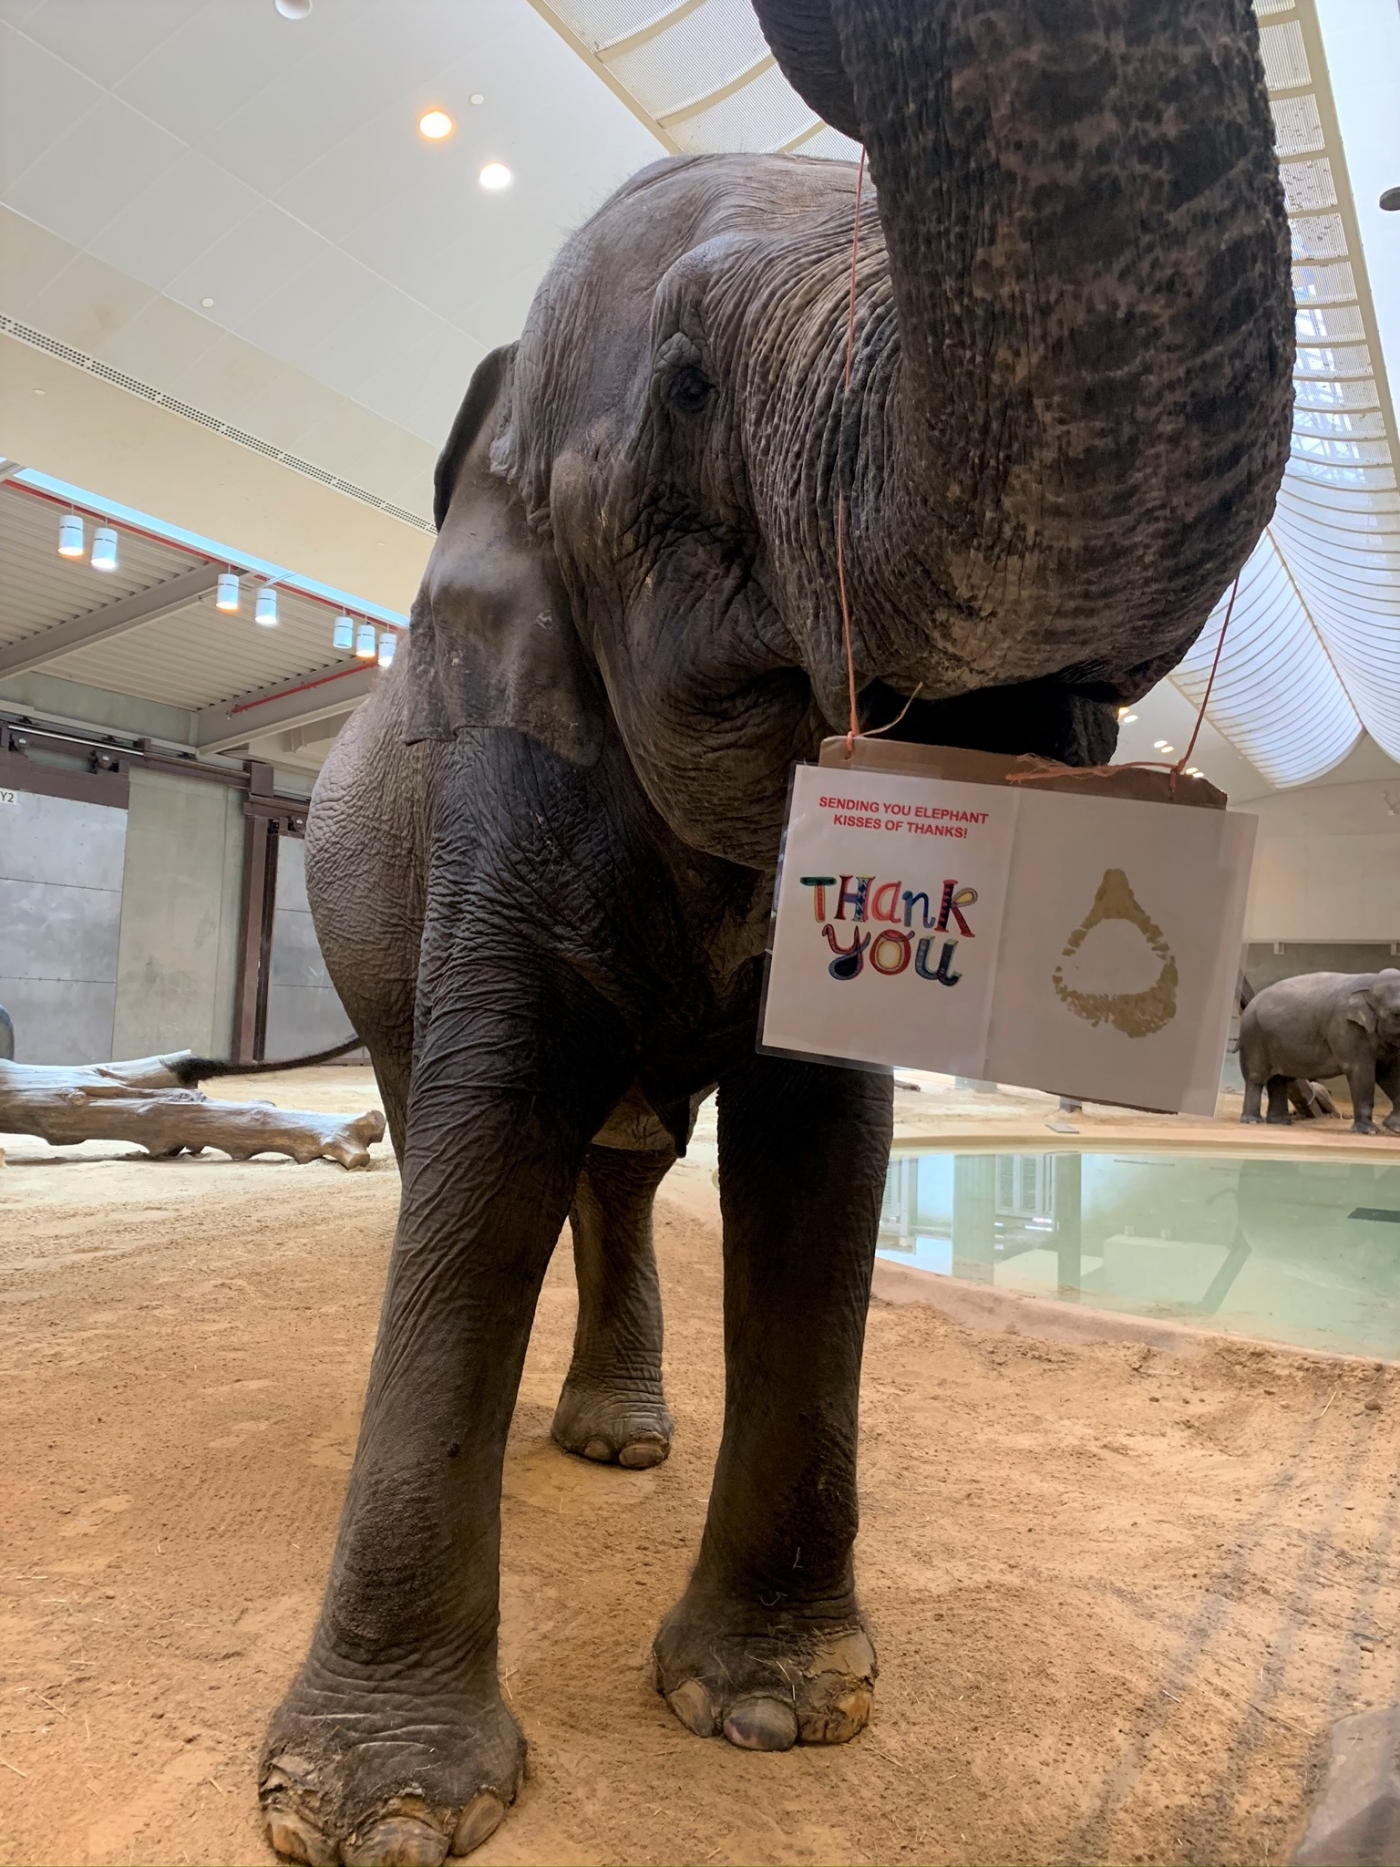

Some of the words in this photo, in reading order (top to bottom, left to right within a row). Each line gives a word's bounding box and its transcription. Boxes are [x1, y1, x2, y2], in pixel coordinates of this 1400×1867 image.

[819, 796, 879, 813] SENDING
[883, 802, 911, 817] YOU
[914, 806, 989, 825] ELEPHANT
[833, 814, 882, 830] KISSES
[884, 819, 904, 832] OF
[907, 822, 968, 839] THANKS!
